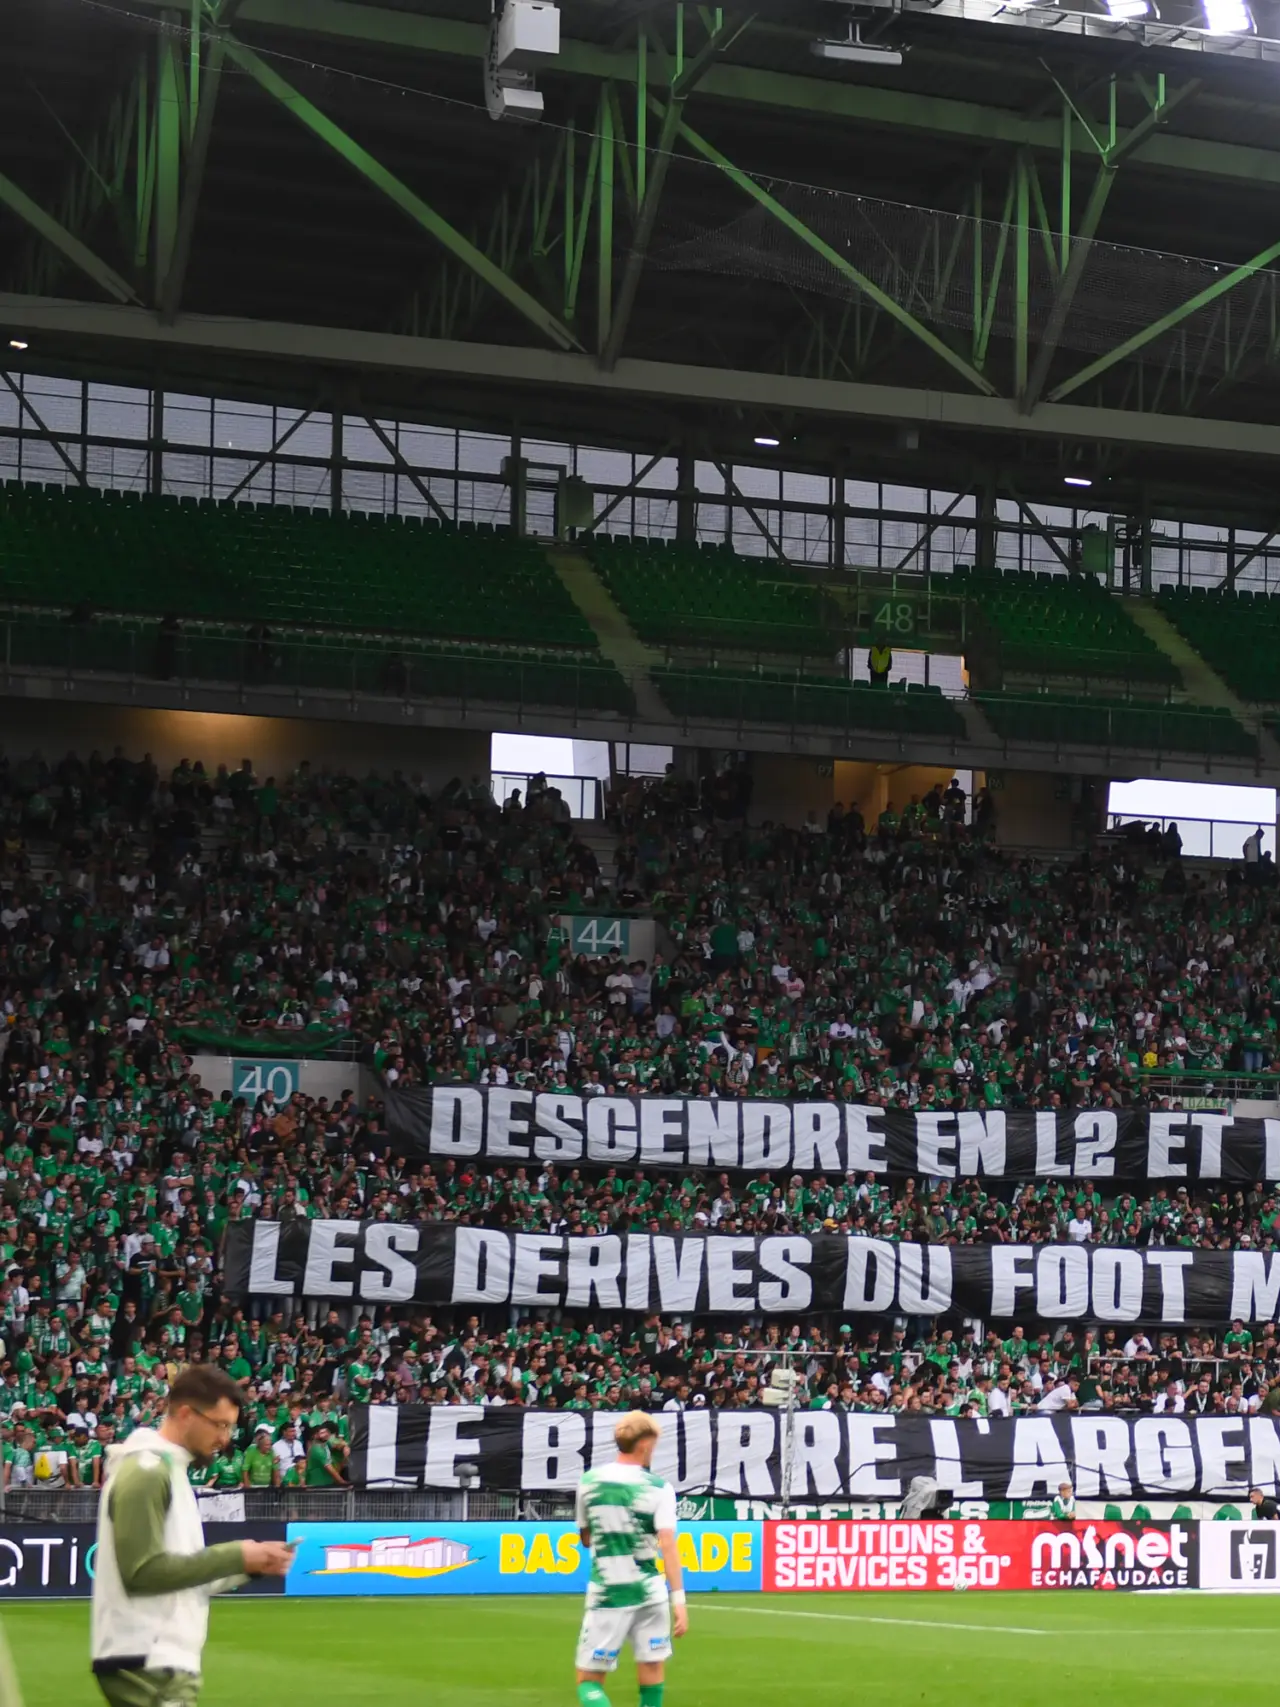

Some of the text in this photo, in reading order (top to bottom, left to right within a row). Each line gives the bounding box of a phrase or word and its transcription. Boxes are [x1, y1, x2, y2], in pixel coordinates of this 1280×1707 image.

[874, 602, 914, 633] 48
[577, 919, 624, 952] 44
[238, 1066, 293, 1105] 40
[429, 1086, 887, 1174] DESCENDRE
[914, 1110, 1006, 1177] EN
[1035, 1110, 1118, 1178] L2
[1147, 1111, 1234, 1178] ET
[247, 1219, 419, 1301] LES
[451, 1226, 812, 1313] DERIVES
[842, 1235, 953, 1315] DU
[990, 1244, 1194, 1324] FOOT
[365, 1404, 485, 1490] LE
[775, 1523, 987, 1554] SOLUTIONS &
[775, 1555, 927, 1587] SERVICES
[1031, 1570, 1188, 1586] ECHAFAUDAGE
